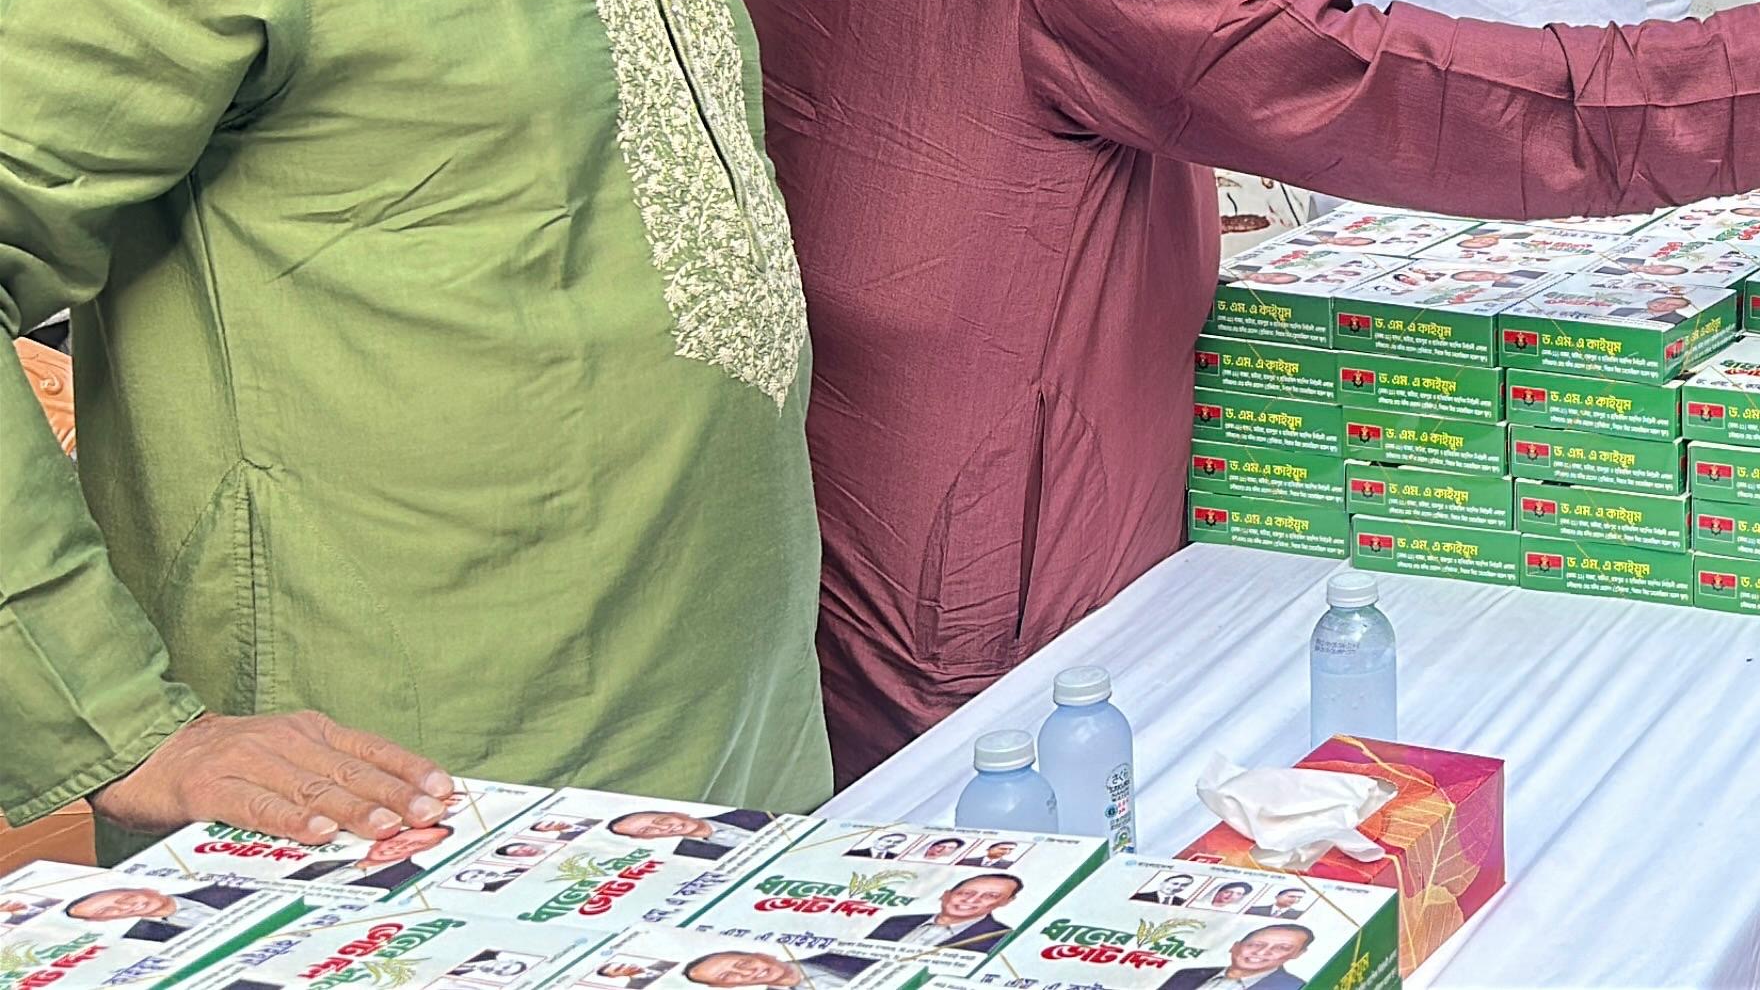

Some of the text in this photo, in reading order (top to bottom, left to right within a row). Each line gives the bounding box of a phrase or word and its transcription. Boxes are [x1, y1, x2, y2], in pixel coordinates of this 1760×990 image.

[754, 874, 848, 899] ধানের
[754, 896, 888, 918] ভোট দিন
[1039, 917, 1134, 948] ধানের
[1040, 944, 1173, 971] ভোট দিন
